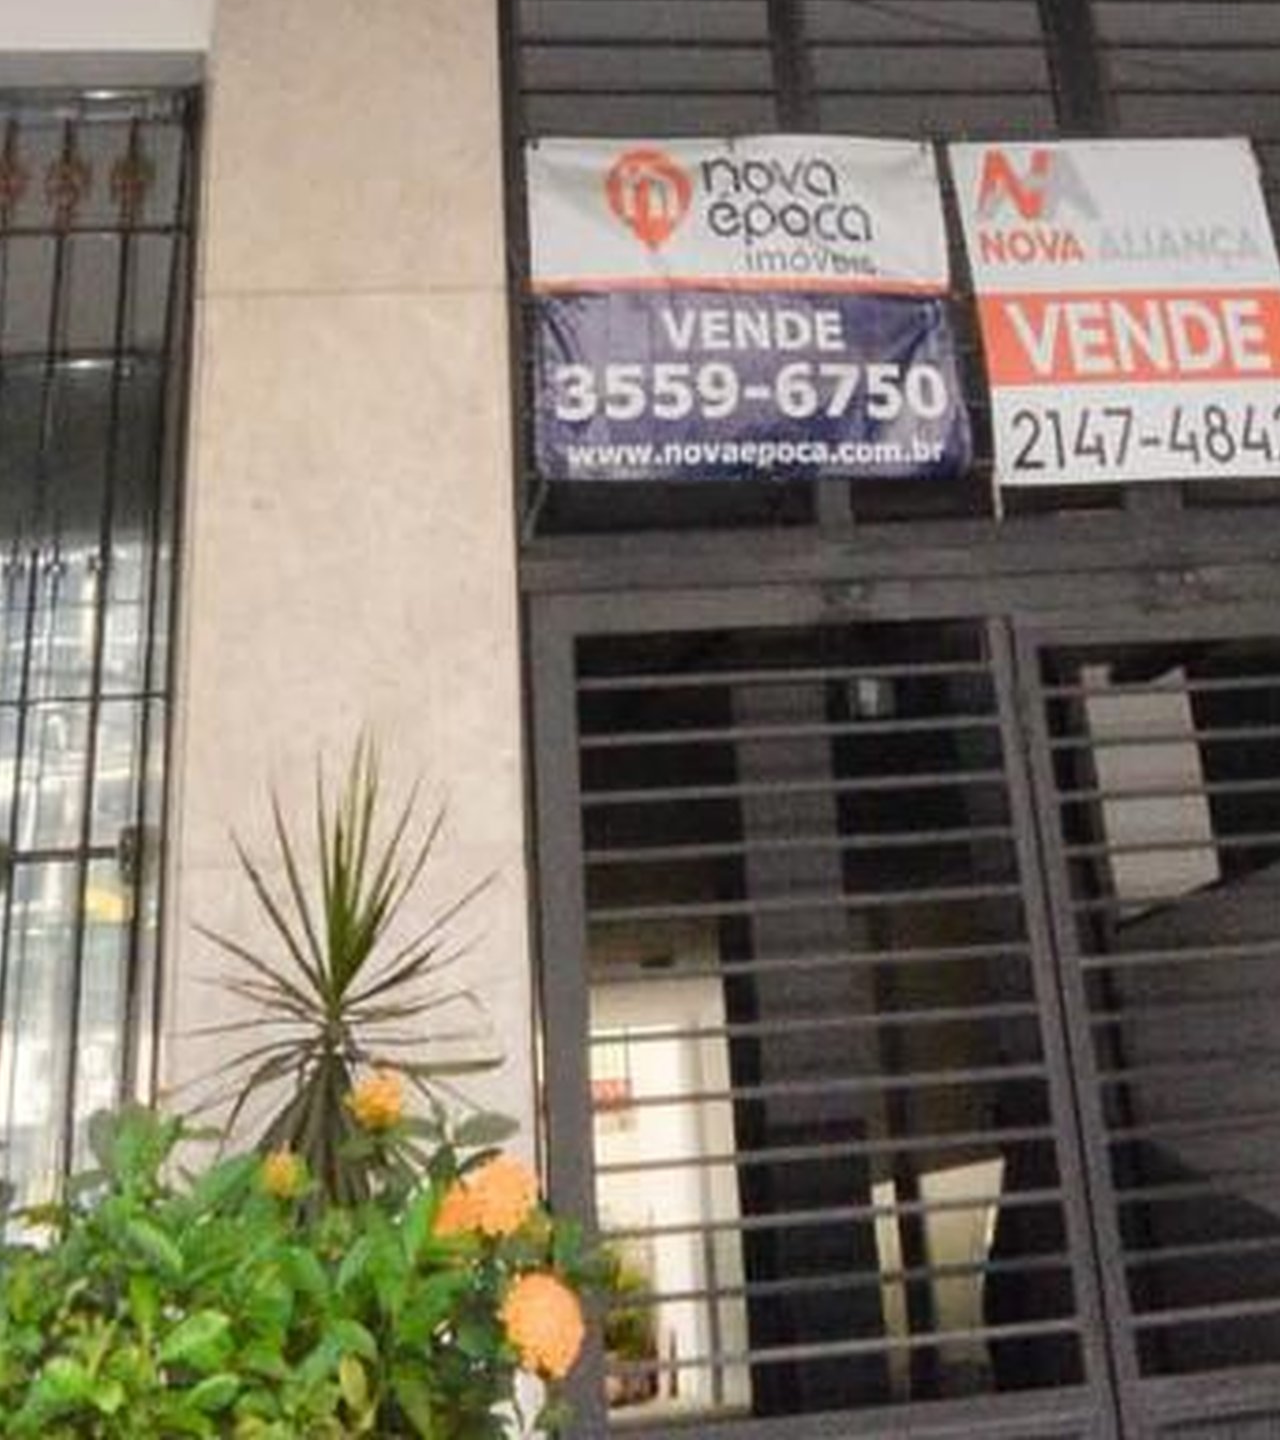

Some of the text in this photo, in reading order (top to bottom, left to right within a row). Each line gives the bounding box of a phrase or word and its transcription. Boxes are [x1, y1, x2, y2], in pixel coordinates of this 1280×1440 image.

[700, 157, 839, 197] nova
[979, 229, 1085, 265] NOVA
[662, 309, 846, 352] VENDE
[1004, 298, 1273, 376] VENDE
[553, 363, 949, 423] 3559-6750
[566, 438, 949, 469] www.novaepoca.com.br
